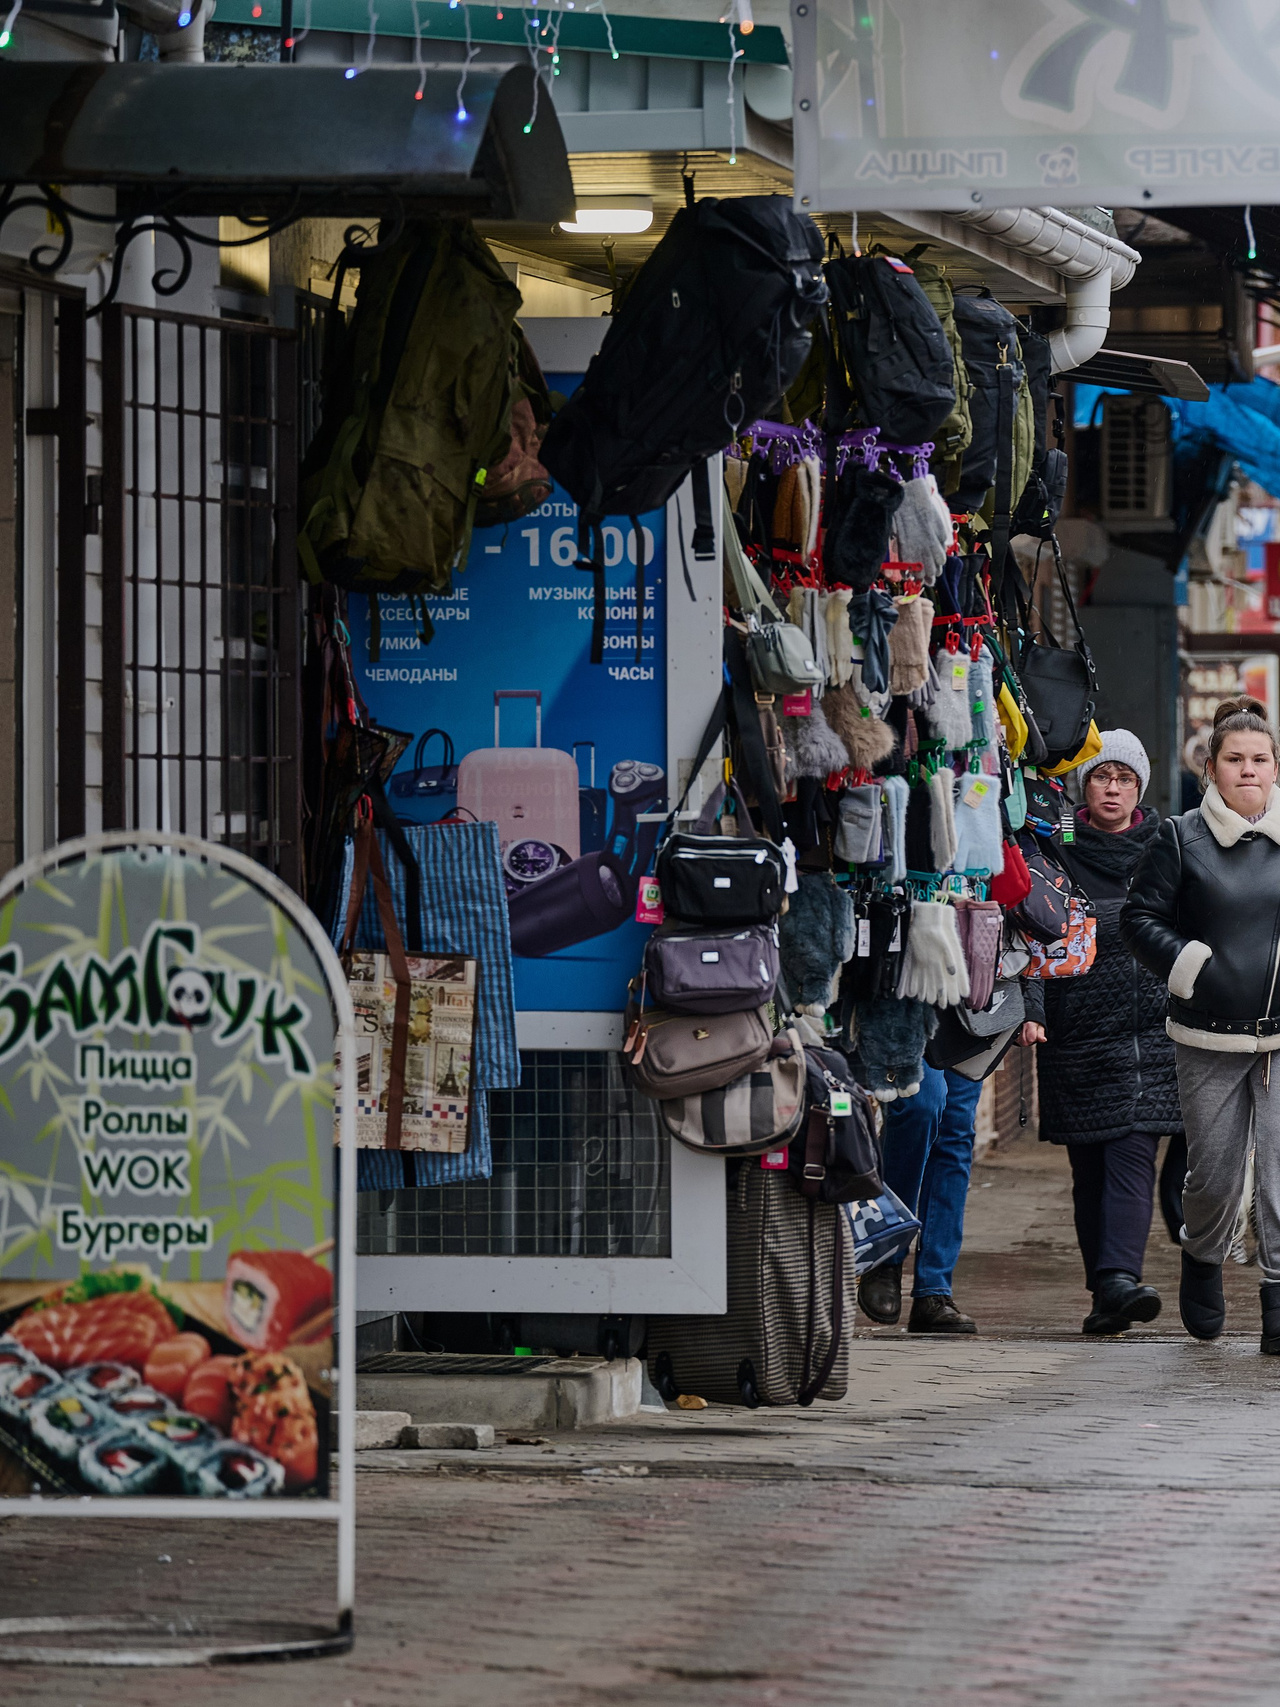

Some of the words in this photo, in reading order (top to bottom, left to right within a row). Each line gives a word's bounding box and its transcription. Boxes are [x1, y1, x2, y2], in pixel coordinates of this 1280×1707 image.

[523, 503, 577, 517] БОТЫ
[521, 526, 655, 567] 1600
[365, 668, 458, 684] ЧЕМОДАНЫ
[608, 667, 654, 680] ЧАСЫ
[79, 1045, 192, 1083] Пицца
[83, 1101, 188, 1135] Роллы
[83, 1156, 188, 1190] WOK
[62, 1212, 208, 1254] Бургеры
